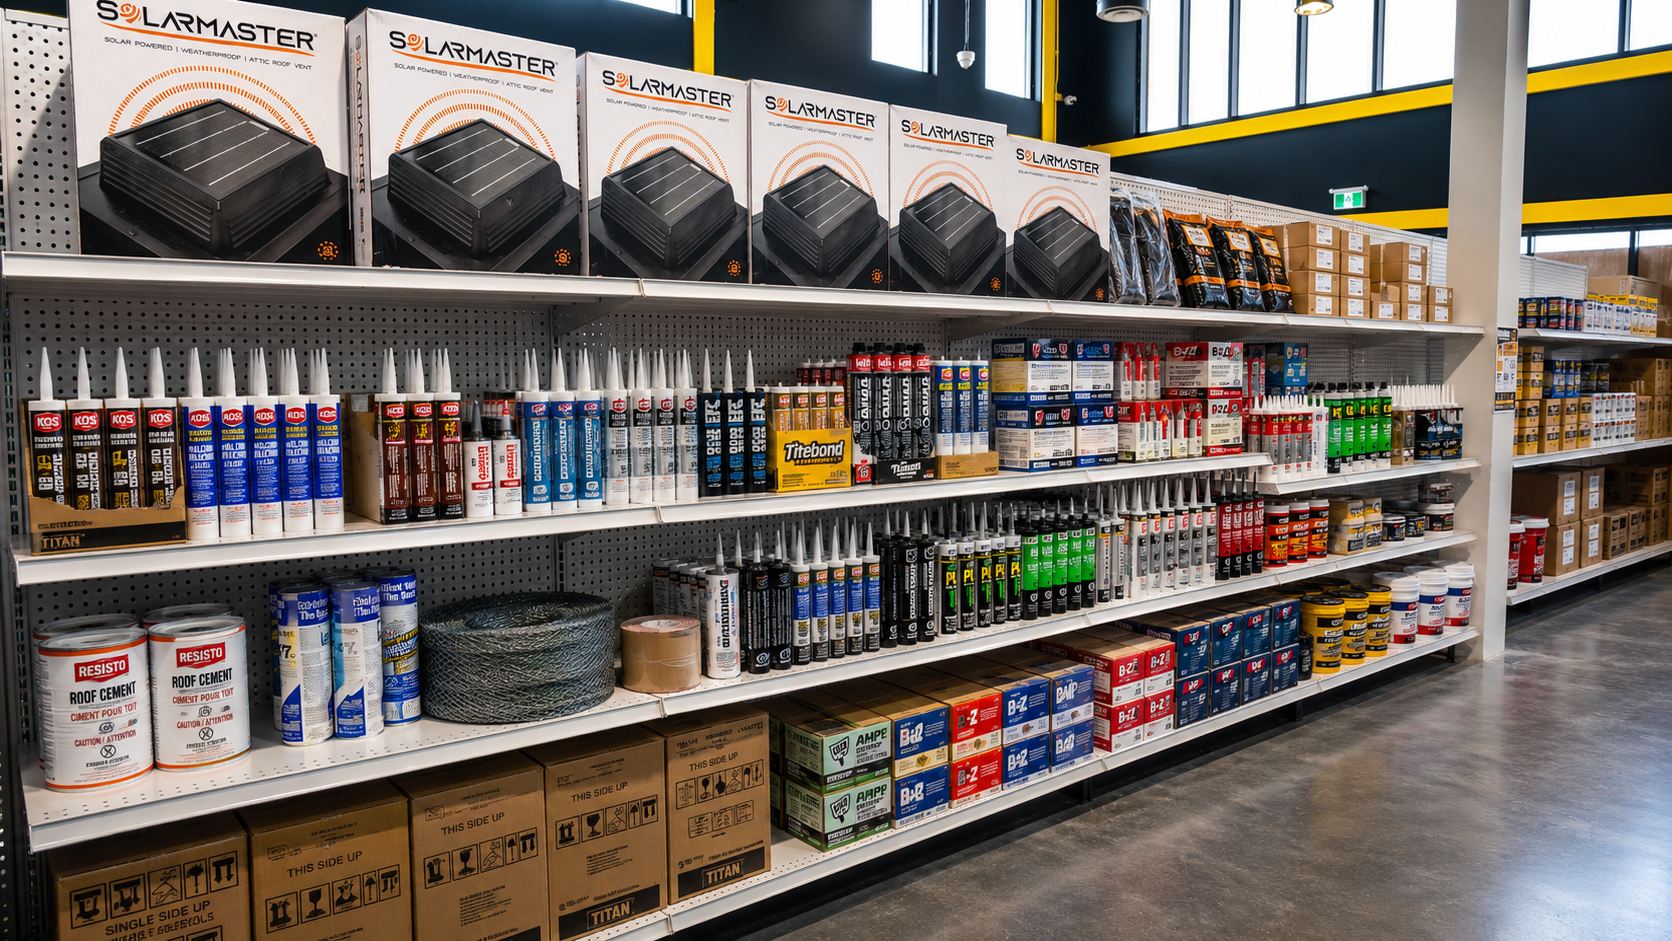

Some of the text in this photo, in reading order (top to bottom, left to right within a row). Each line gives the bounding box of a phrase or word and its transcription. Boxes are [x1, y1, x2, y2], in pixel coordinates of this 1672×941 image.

[104, 36, 131, 45] SOLAR
[135, 40, 173, 51] POWERED
[181, 47, 241, 60] WEATHERPROOF
[249, 57, 269, 65] ATTIC
[389, 30, 555, 76] SOLARMASTER
[394, 62, 415, 70] SOLAR
[602, 70, 732, 107] SOLARMASTER
[765, 95, 875, 128] SOLARMASTER
[901, 119, 994, 147] SOLARMASTER
[1016, 148, 1099, 174] SOLARMASTER
[42, 535, 80, 548] TITAN
[180, 647, 223, 662] RESISTO
[79, 660, 126, 677] RESISTO
[172, 667, 233, 688] ROOF CEMENT
[70, 680, 136, 705] ROOF CEMENT
[102, 706, 123, 718] POUR
[689, 751, 738, 772] THIS SIDE UP
[570, 781, 628, 803] THIS SIDE UP
[440, 811, 505, 836] THIS SIDE UP
[286, 850, 363, 878] THIS SIDE UP
[705, 860, 742, 884] TITAN
[105, 914, 154, 936] SINGLE
[158, 905, 189, 922] SIDE
[193, 900, 210, 913] UP
[591, 901, 631, 926] TITAN
